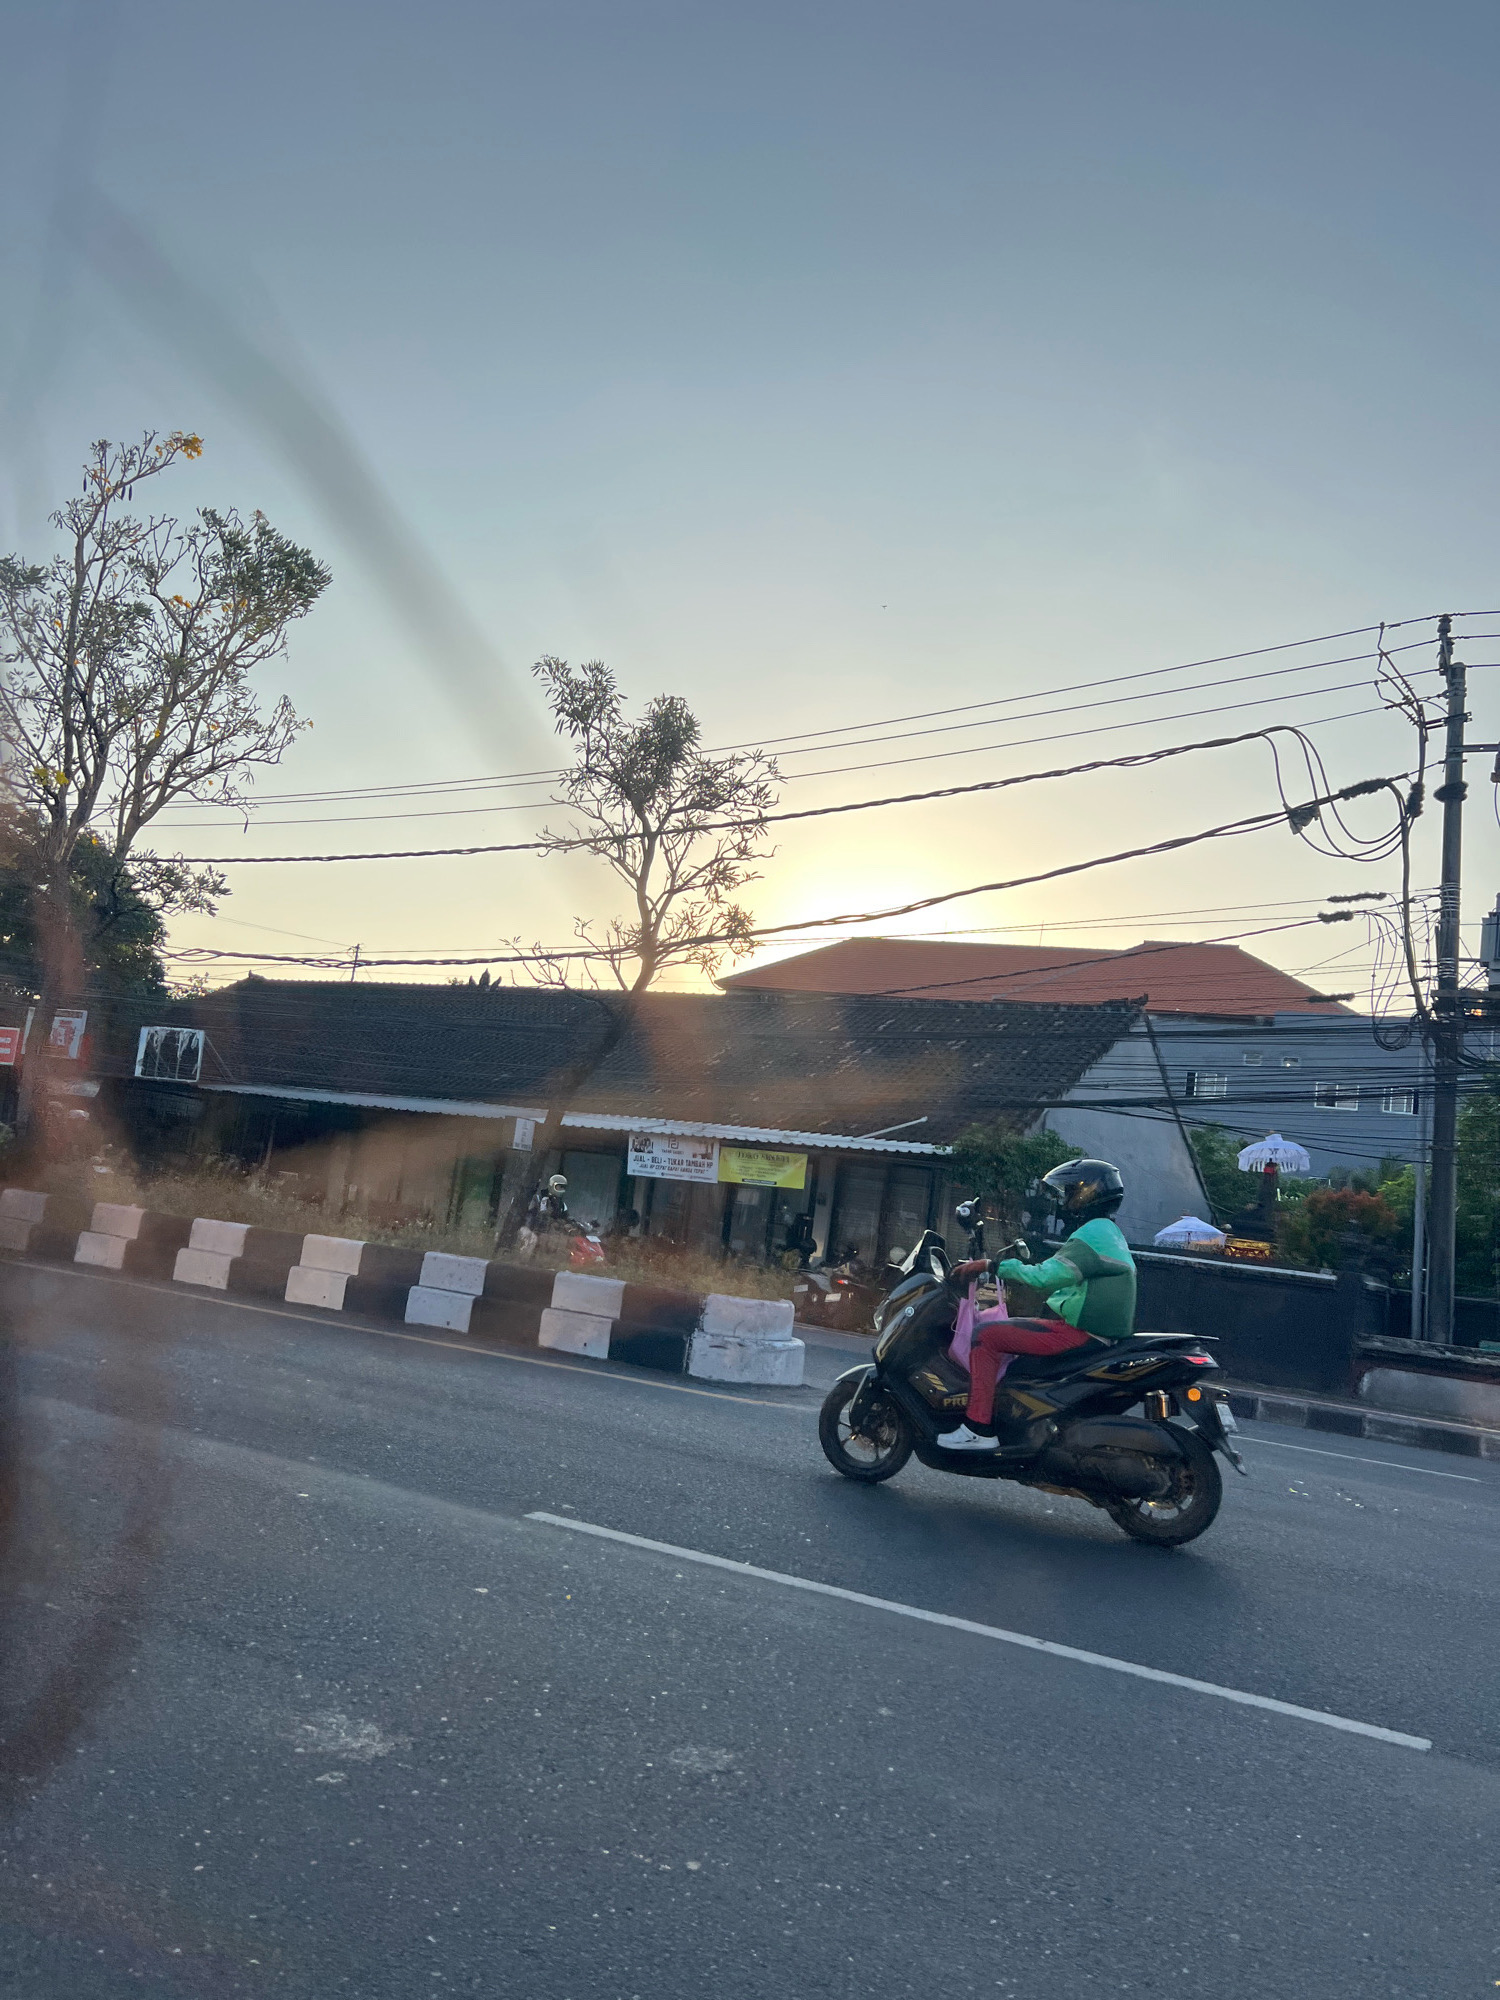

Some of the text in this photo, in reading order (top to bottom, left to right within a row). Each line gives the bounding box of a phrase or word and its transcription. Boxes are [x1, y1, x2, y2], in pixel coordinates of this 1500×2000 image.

[651, 1156, 662, 1164] BELI
[667, 1157, 684, 1166] TUKAR
[685, 1159, 705, 1168] TAMBAH
[706, 1161, 713, 1169] HP
